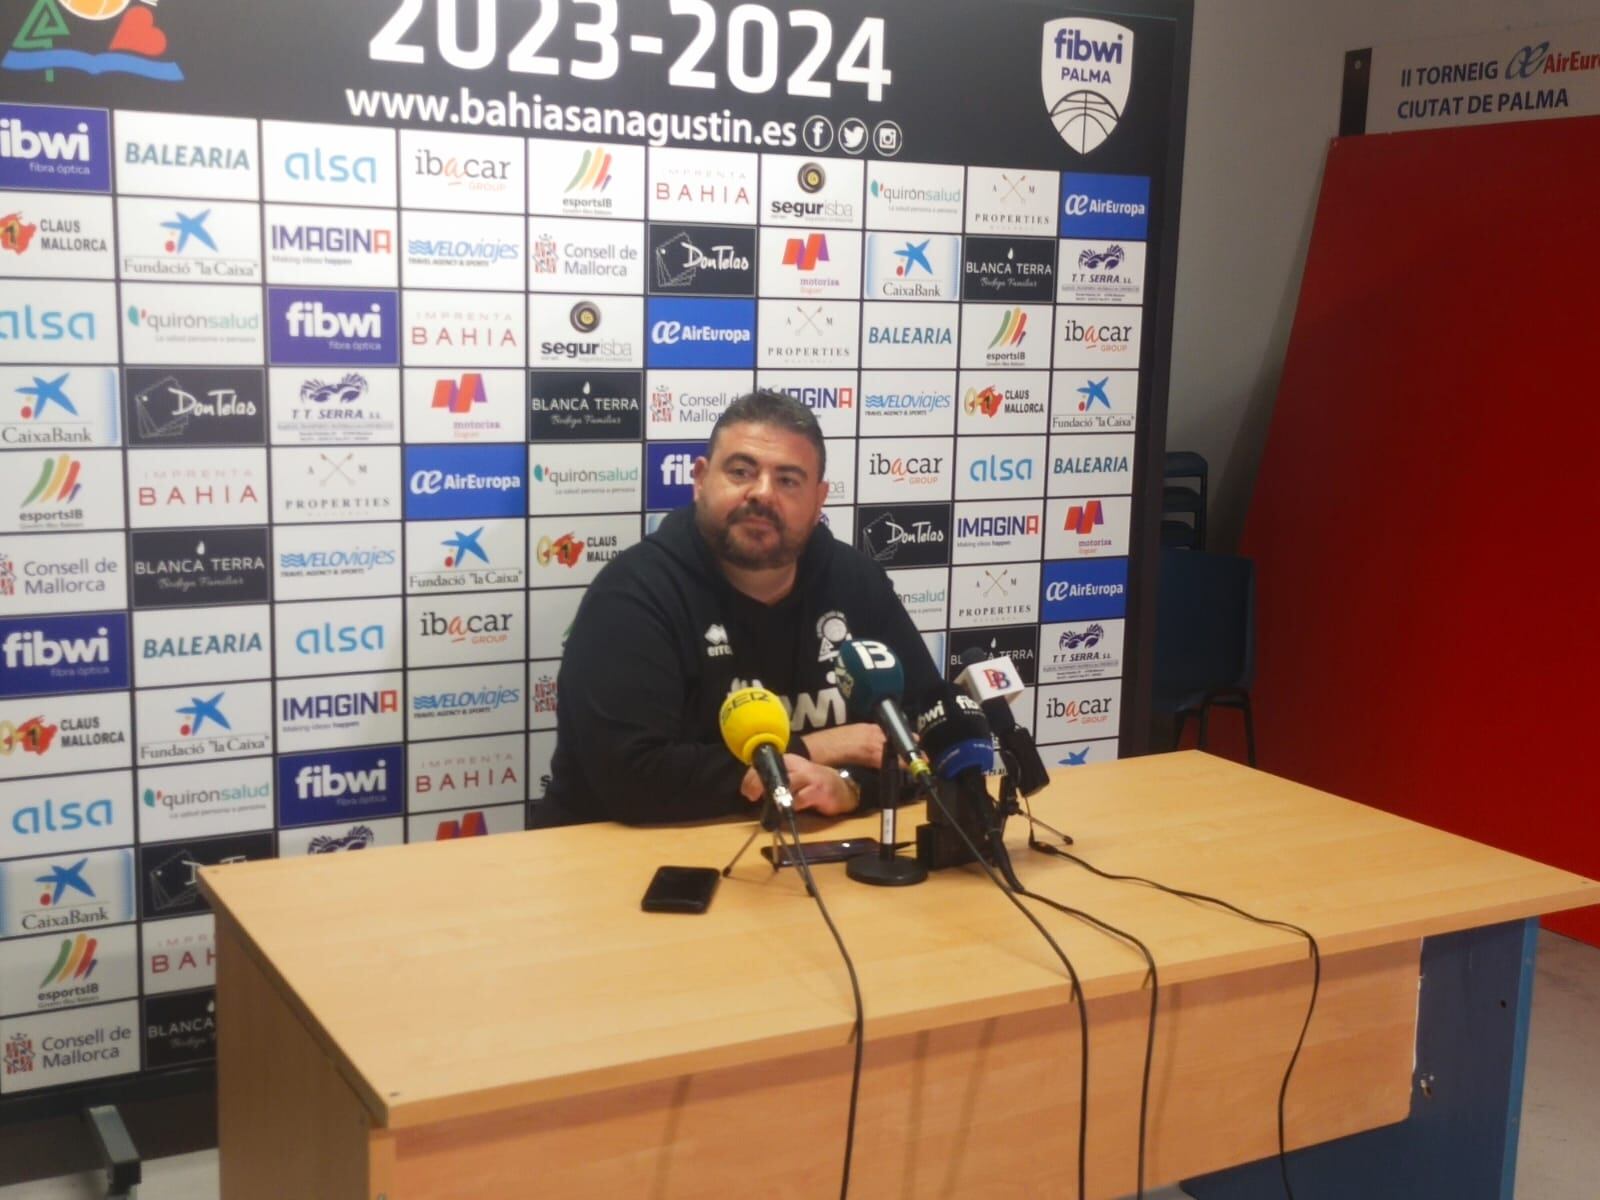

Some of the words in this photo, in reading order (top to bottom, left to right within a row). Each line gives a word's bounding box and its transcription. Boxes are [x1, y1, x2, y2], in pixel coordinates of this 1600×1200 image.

[368, 0, 893, 103] 2023-2024
[1054, 28, 1124, 65] fibwi
[1061, 67, 1112, 86] PALMA
[1400, 69, 1412, 87] II
[1415, 61, 1498, 86] TORNEIG
[1397, 96, 1464, 119] CIUTAT
[1467, 94, 1493, 114] DE
[1498, 88, 1568, 112] PALMA
[344, 87, 797, 147] www.bahiasanagustin.es
[0, 118, 90, 161] ibwi
[285, 147, 377, 184] alsa
[415, 149, 511, 182] ibacar
[656, 182, 749, 205] BAHIA
[771, 200, 853, 218] segurisba
[1089, 199, 1145, 217] AirEuropa
[40, 219, 80, 233] CLAUS
[975, 213, 1050, 225] PROPERTIES
[40, 237, 107, 252] MALLORCA
[271, 224, 392, 255] IMAGINA
[564, 243, 616, 259] Consell
[620, 245, 637, 260] de
[124, 259, 191, 274] Fundació
[565, 261, 628, 277] Mallorca
[966, 262, 1012, 274] BLANCA
[1016, 263, 1052, 275] TERRA
[1089, 274, 1120, 284] SERRA
[883, 282, 941, 297] CaixaBank
[285, 301, 382, 338] fibwi
[412, 327, 517, 347] BAHIA
[682, 326, 750, 344] AirEuropa
[1065, 320, 1132, 343] ibacar
[541, 340, 632, 359] segurisba
[768, 347, 850, 357] PROPERTIES
[532, 398, 590, 411] BLANCA
[595, 398, 639, 411] TERRA
[679, 393, 727, 407] Consell
[1005, 390, 1029, 400] CLAUS
[318, 409, 364, 420] SERRA
[1004, 403, 1044, 413] MALLORCA
[1052, 417, 1093, 428] Fundació
[1, 427, 92, 443] CaixaBank
[661, 454, 695, 485] fib
[869, 453, 943, 476] ibacar
[970, 454, 1032, 482] alsa
[444, 474, 520, 492] AirEuropa
[139, 485, 258, 506] BAHIA
[285, 497, 390, 510] PROPERTIES
[957, 515, 1039, 538] IMAGINA
[587, 536, 617, 547] CLAUS
[24, 558, 88, 576] Consell
[95, 557, 117, 573] de
[135, 559, 204, 575] BLANCA
[212, 557, 265, 571] TERRA
[25, 578, 105, 595] Mallorca
[410, 575, 465, 588] Fundació
[1069, 582, 1123, 598] AirEuropa
[958, 604, 1031, 617] PROPERTIES
[420, 612, 512, 638] ibacar
[3, 627, 109, 668] fibwi
[296, 622, 384, 654] alsa
[471, 634, 507, 644] GROUP
[1070, 652, 1099, 661] SERRA
[283, 689, 398, 721] IMAGINA
[1046, 697, 1112, 719] ibacar
[61, 717, 99, 730] CLAUS
[61, 731, 124, 747] MALLORCA
[141, 739, 205, 760] Fundació
[295, 759, 387, 800] fibwi
[416, 767, 517, 793] BAHIA
[12, 799, 113, 834] alsa
[21, 906, 109, 930] CaixaBank
[152, 948, 217, 973] BAH
[148, 1017, 214, 1038] BLANCA
[41, 1028, 105, 1051] Consell
[109, 1026, 131, 1042] de
[43, 1046, 120, 1069] Mallorca
